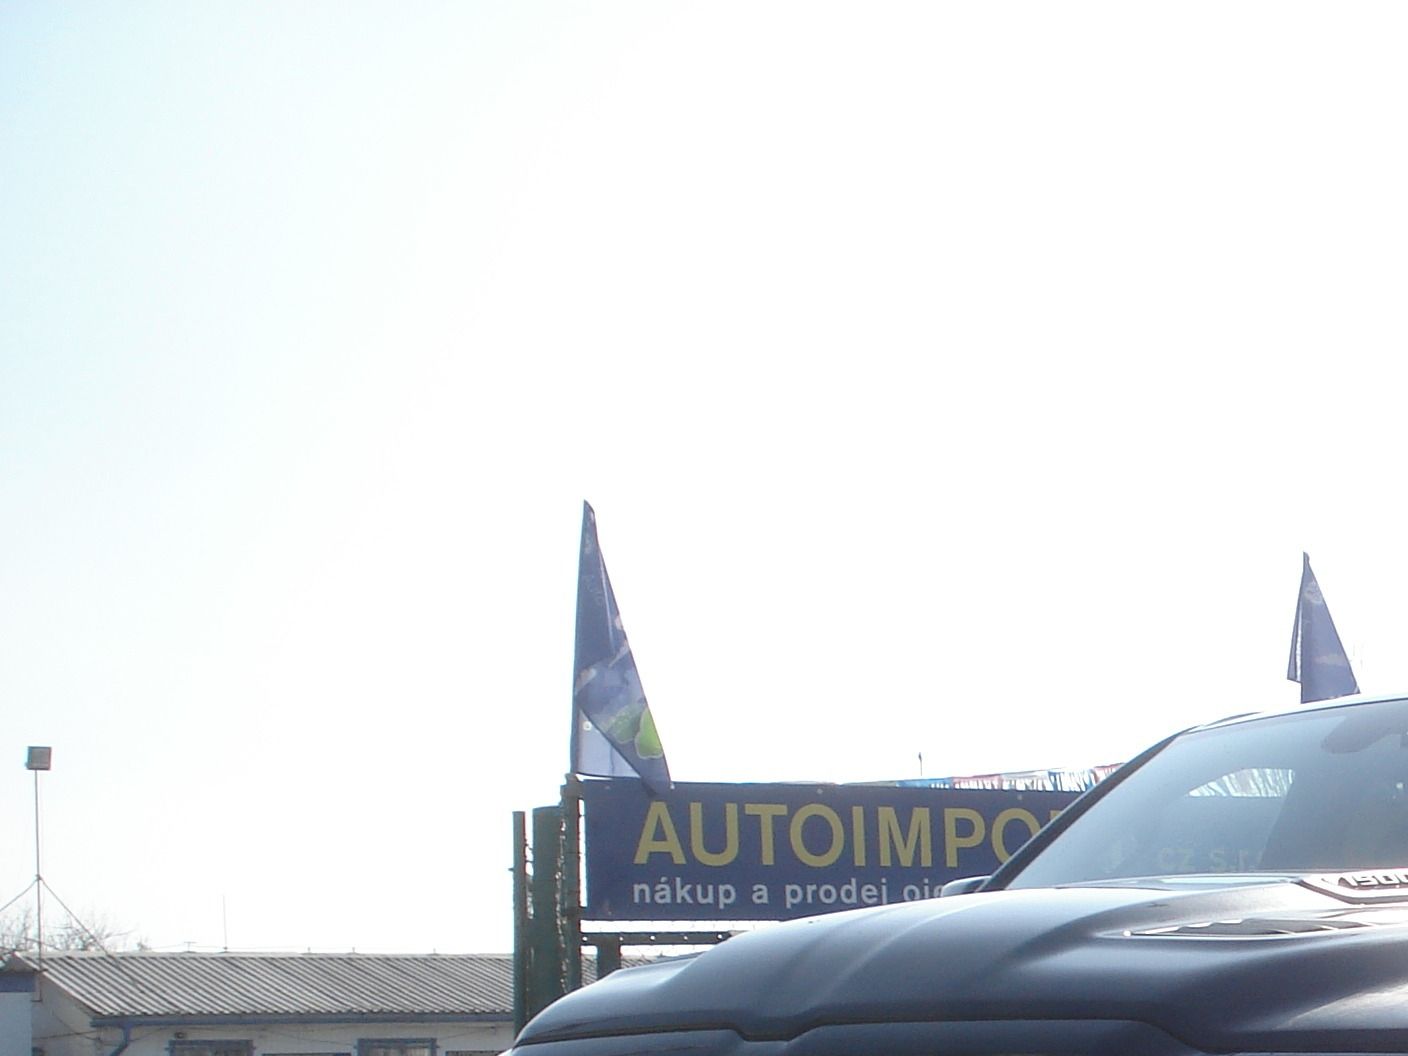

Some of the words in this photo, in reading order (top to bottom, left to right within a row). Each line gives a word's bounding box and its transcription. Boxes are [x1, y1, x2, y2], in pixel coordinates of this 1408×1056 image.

[633, 801, 1060, 868] AUTOIMPO
[632, 877, 737, 909] nákup
[751, 884, 769, 904] a
[785, 878, 887, 908] prodej
